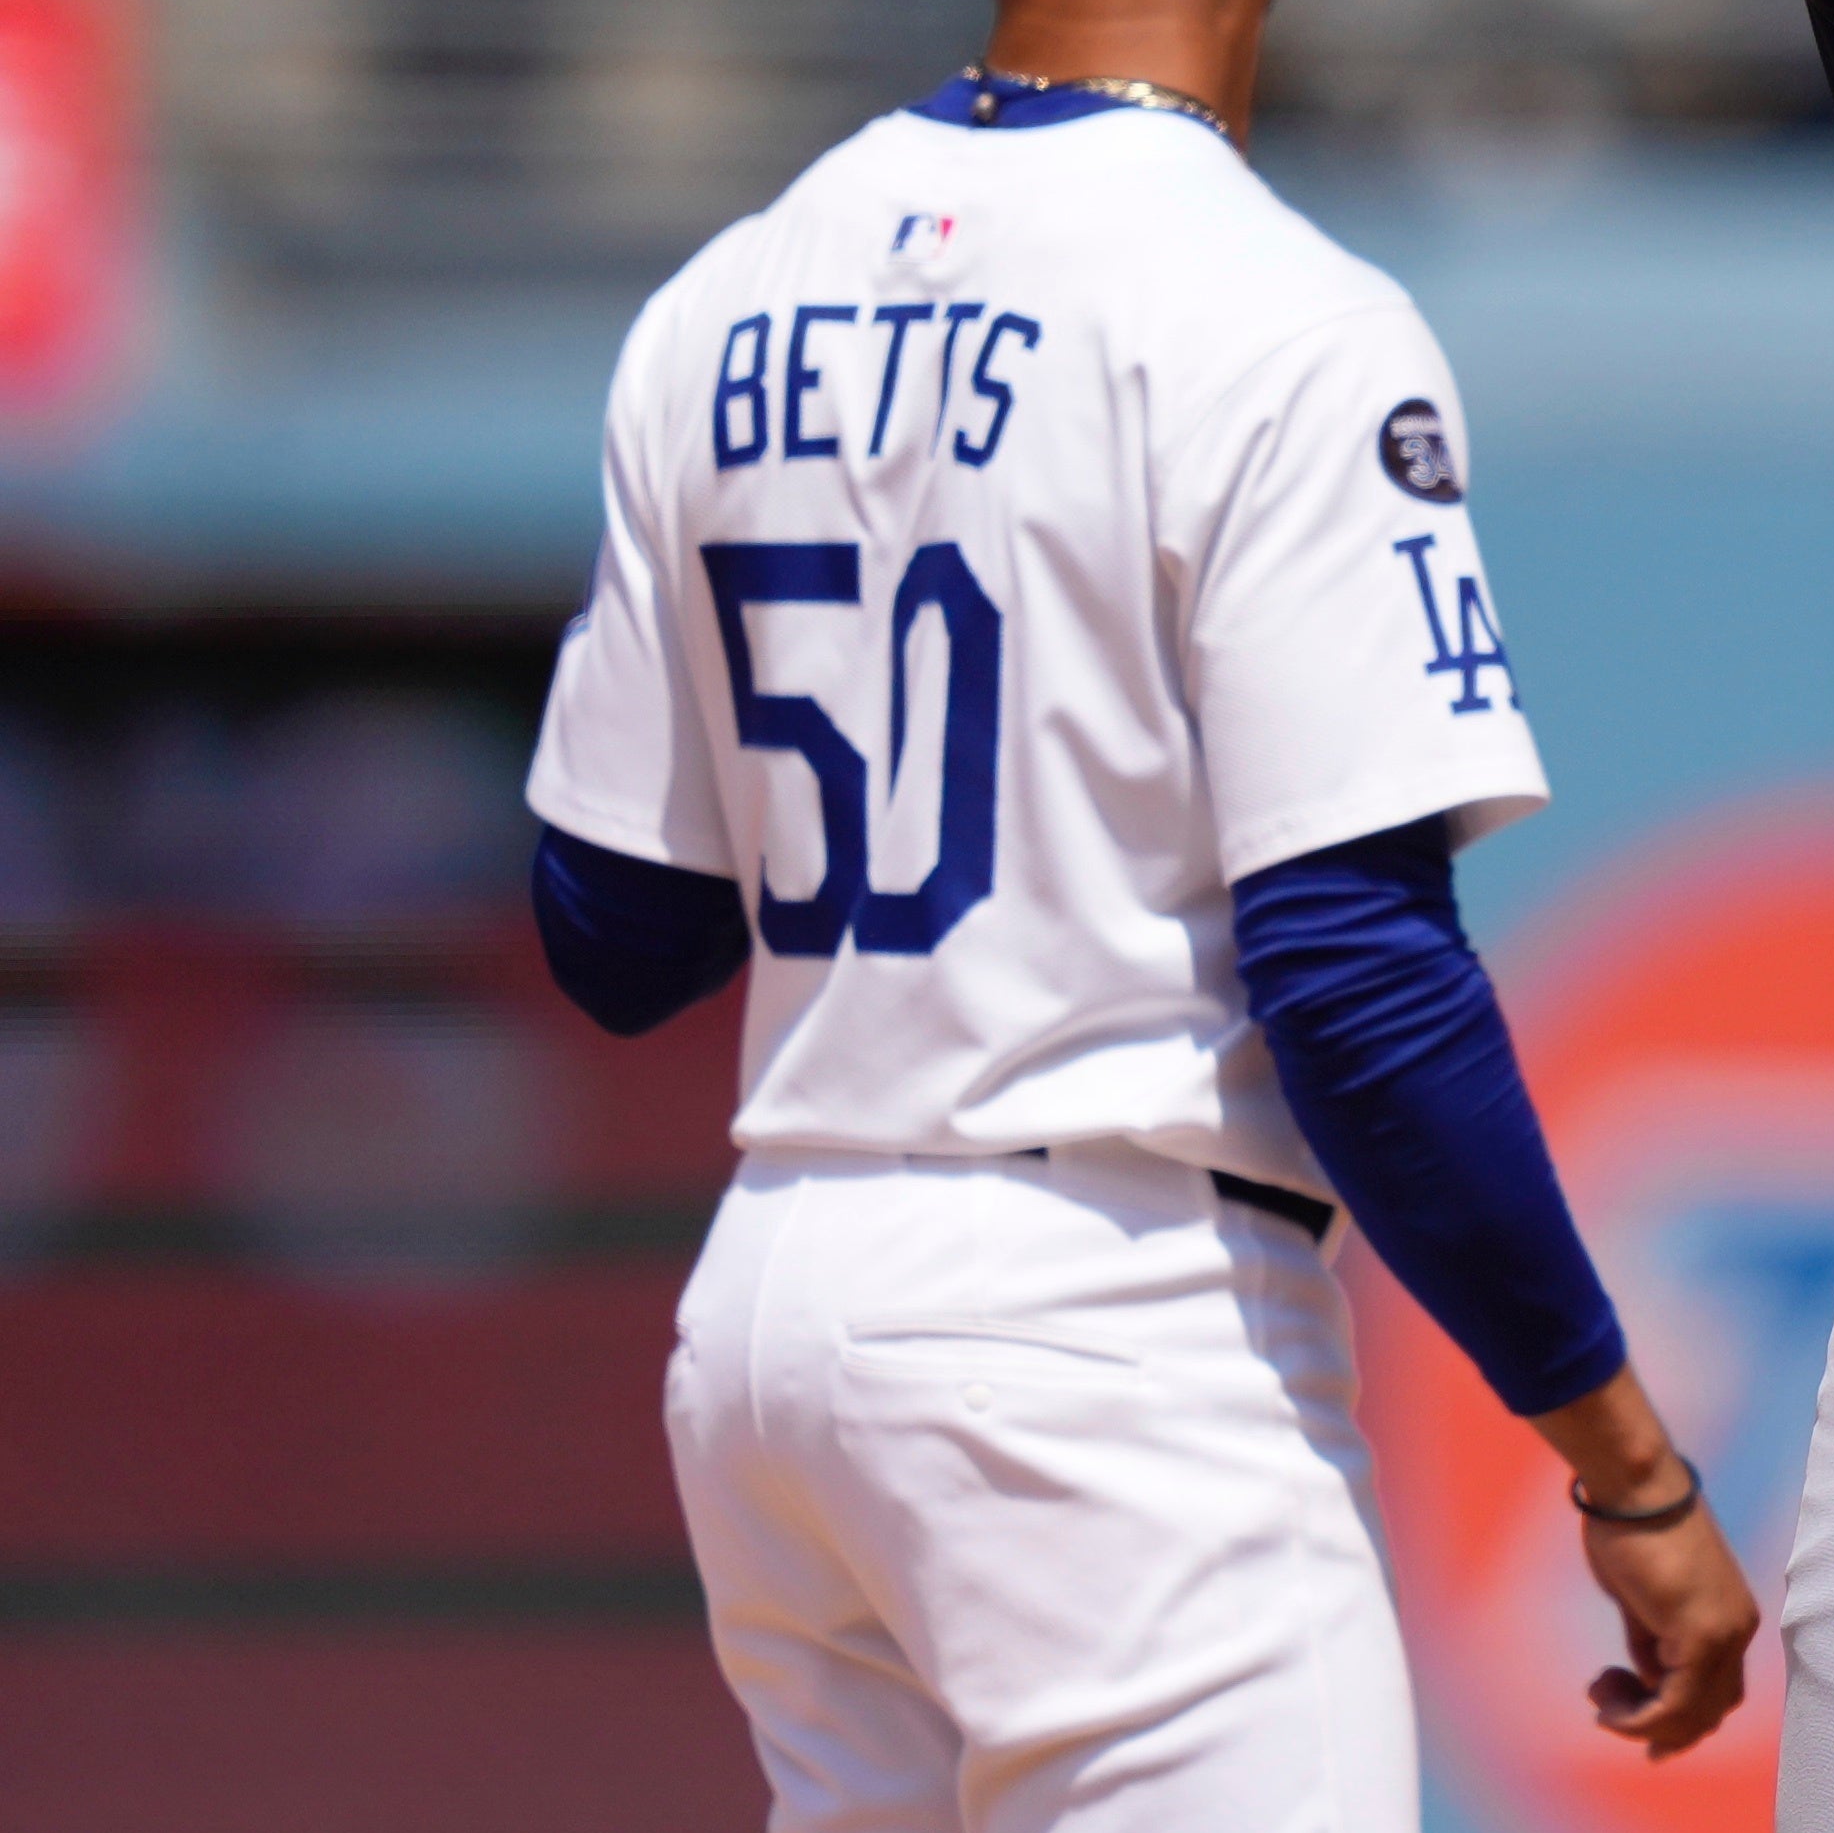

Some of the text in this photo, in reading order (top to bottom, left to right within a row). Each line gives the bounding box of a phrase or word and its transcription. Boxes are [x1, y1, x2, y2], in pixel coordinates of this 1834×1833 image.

[712, 302, 1043, 471] BETTS
[1393, 533, 1521, 715] LA
[699, 540, 1005, 958] 50
